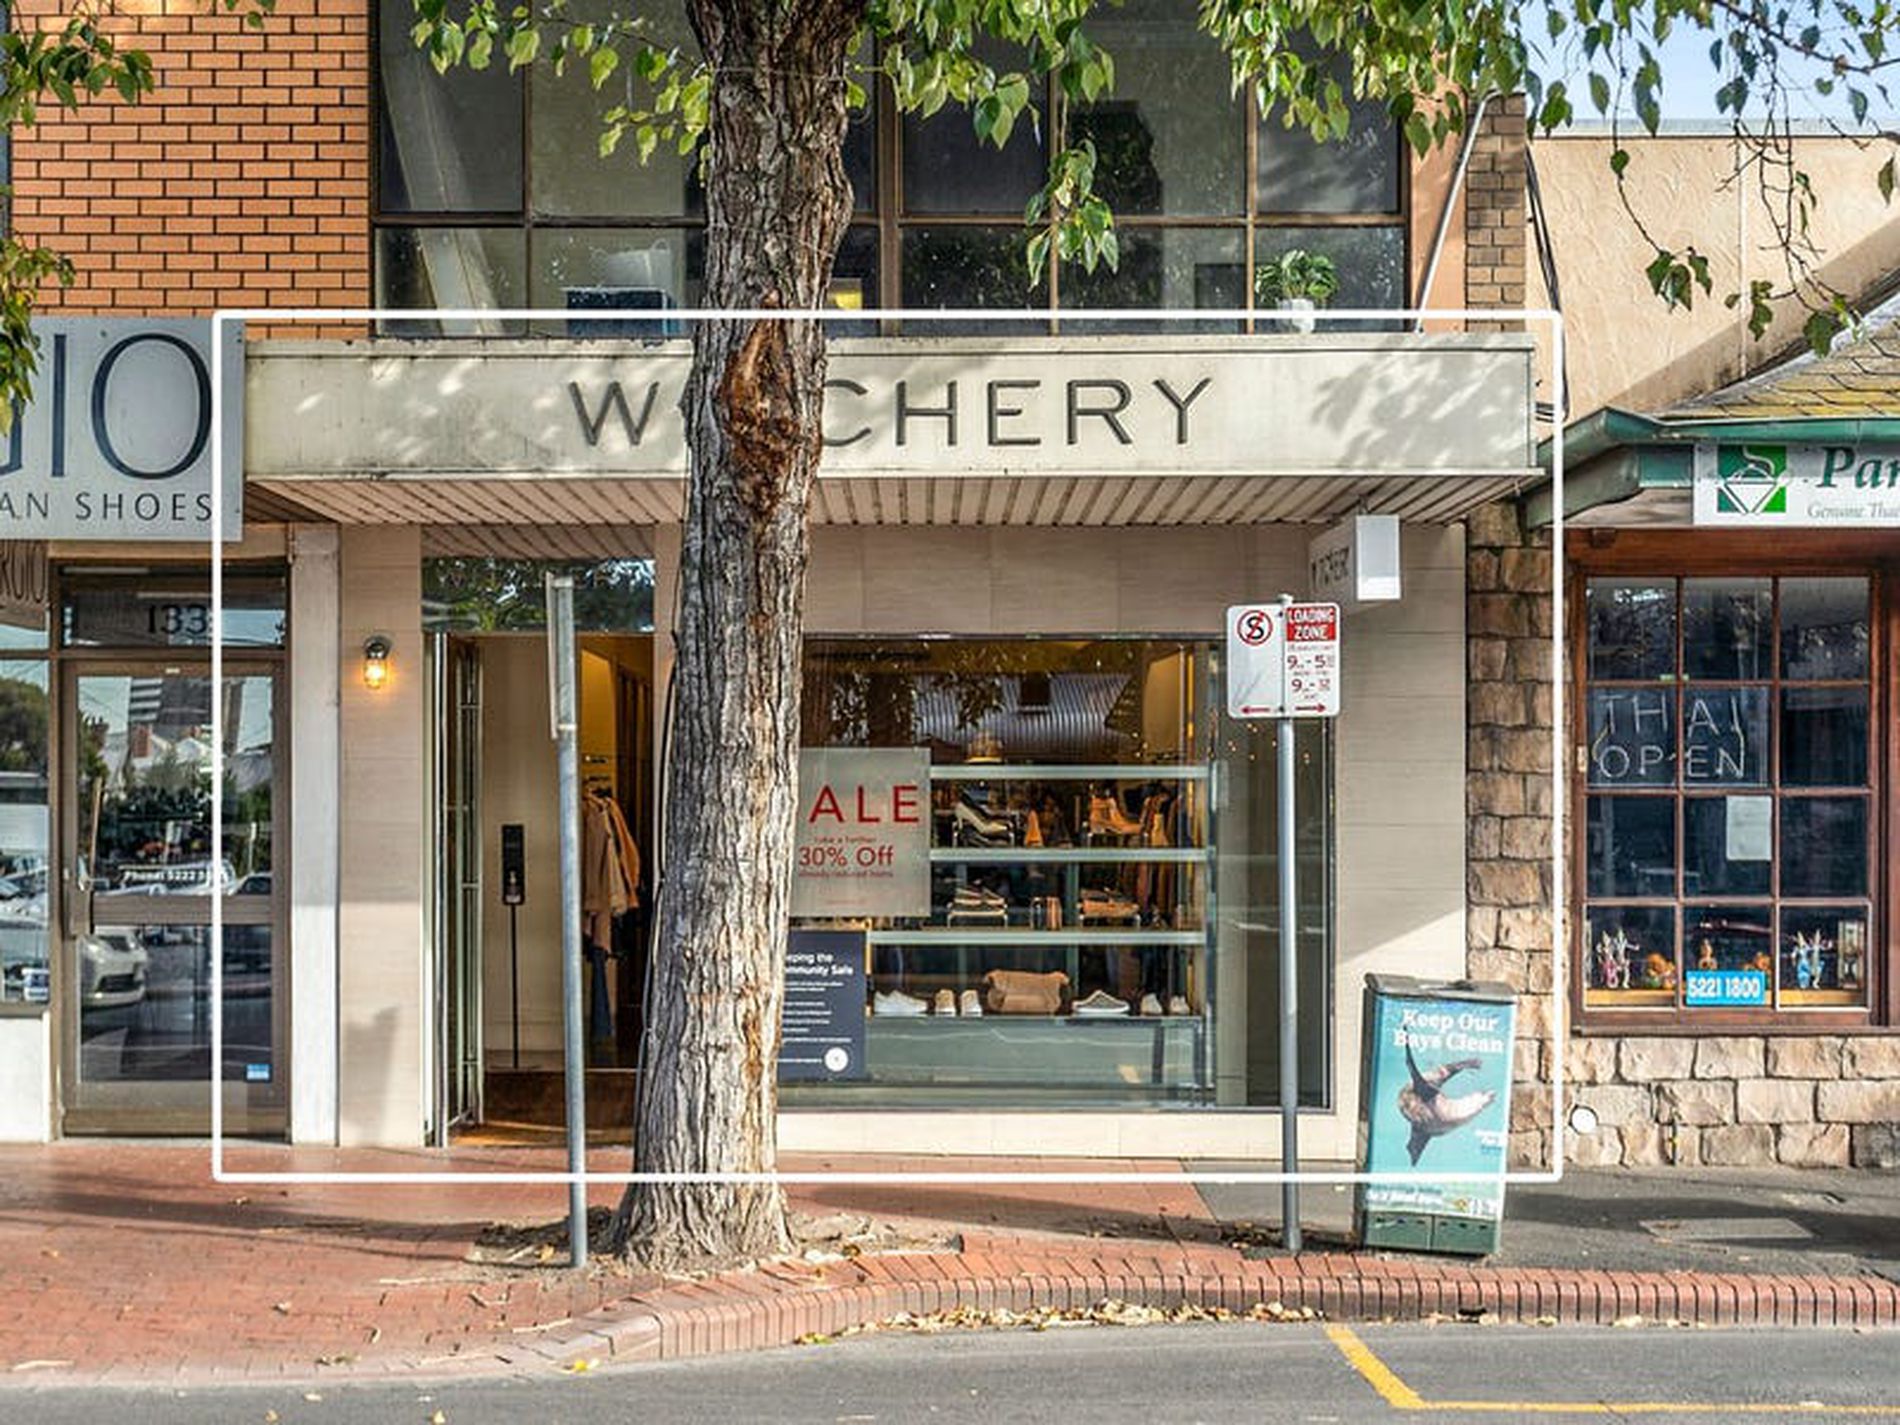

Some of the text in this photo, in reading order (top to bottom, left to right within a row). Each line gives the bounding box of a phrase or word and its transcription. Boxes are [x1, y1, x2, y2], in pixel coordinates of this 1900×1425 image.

[568, 378, 1213, 446] WCHERY
[75, 492, 212, 521] SHOES
[1287, 608, 1336, 624] LOADING
[1294, 625, 1328, 640] ZONE
[1599, 695, 1739, 738] THAI
[1600, 745, 1743, 779] OPEN
[808, 784, 920, 824] ALE
[799, 845, 893, 868] 30% Off
[1687, 977, 1760, 999] 5221 1800
[1402, 1009, 1499, 1034] Keep Our
[1394, 1029, 1504, 1054] Bays Clean
